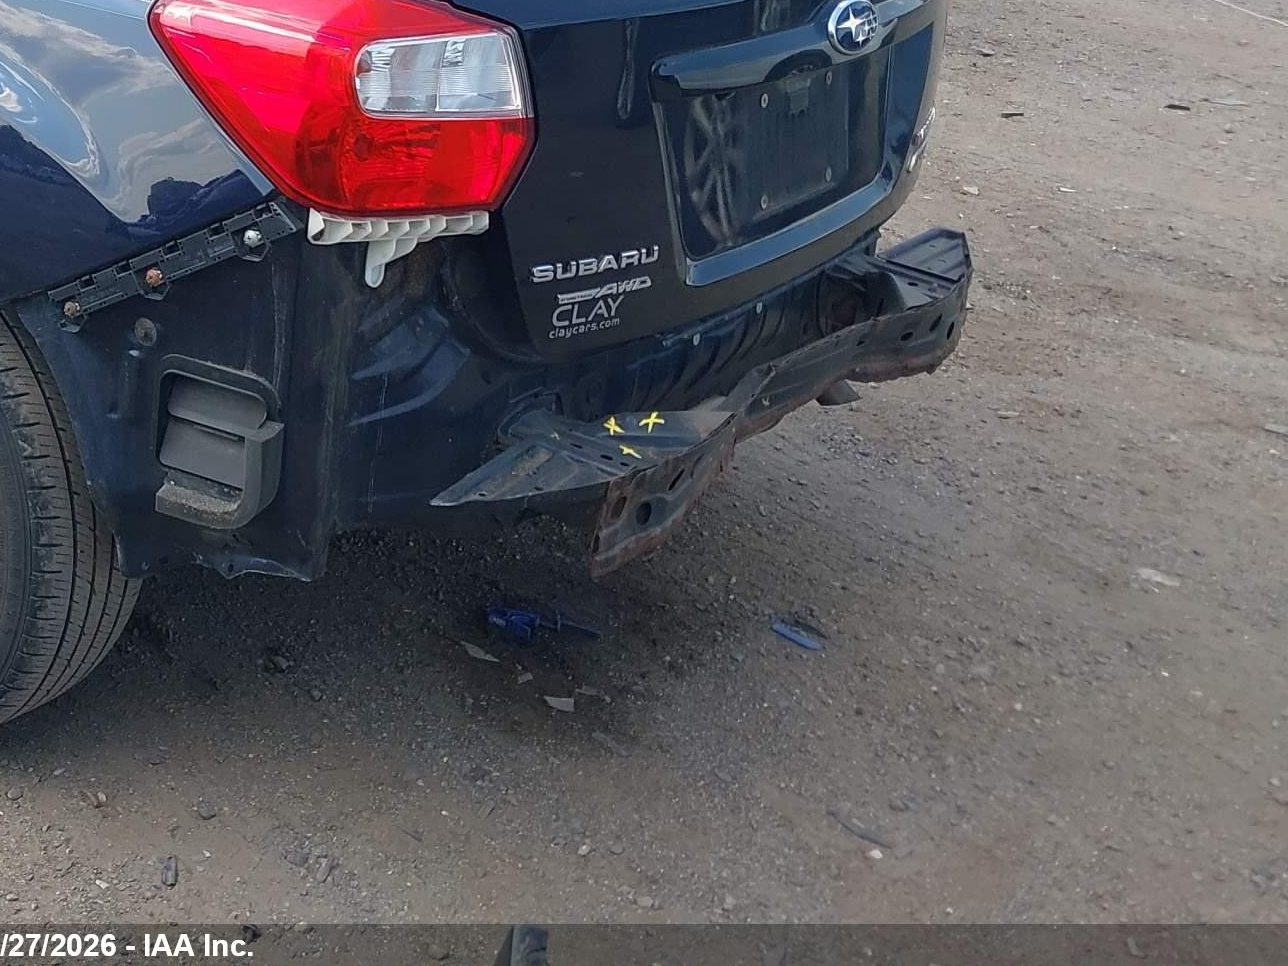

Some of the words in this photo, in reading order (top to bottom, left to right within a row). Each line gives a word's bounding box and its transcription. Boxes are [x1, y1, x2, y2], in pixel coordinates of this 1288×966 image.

[530, 245, 660, 283] SUBARU
[595, 276, 652, 299] AWD
[551, 295, 624, 327] CLAY
[548, 317, 621, 339] claycars.com
